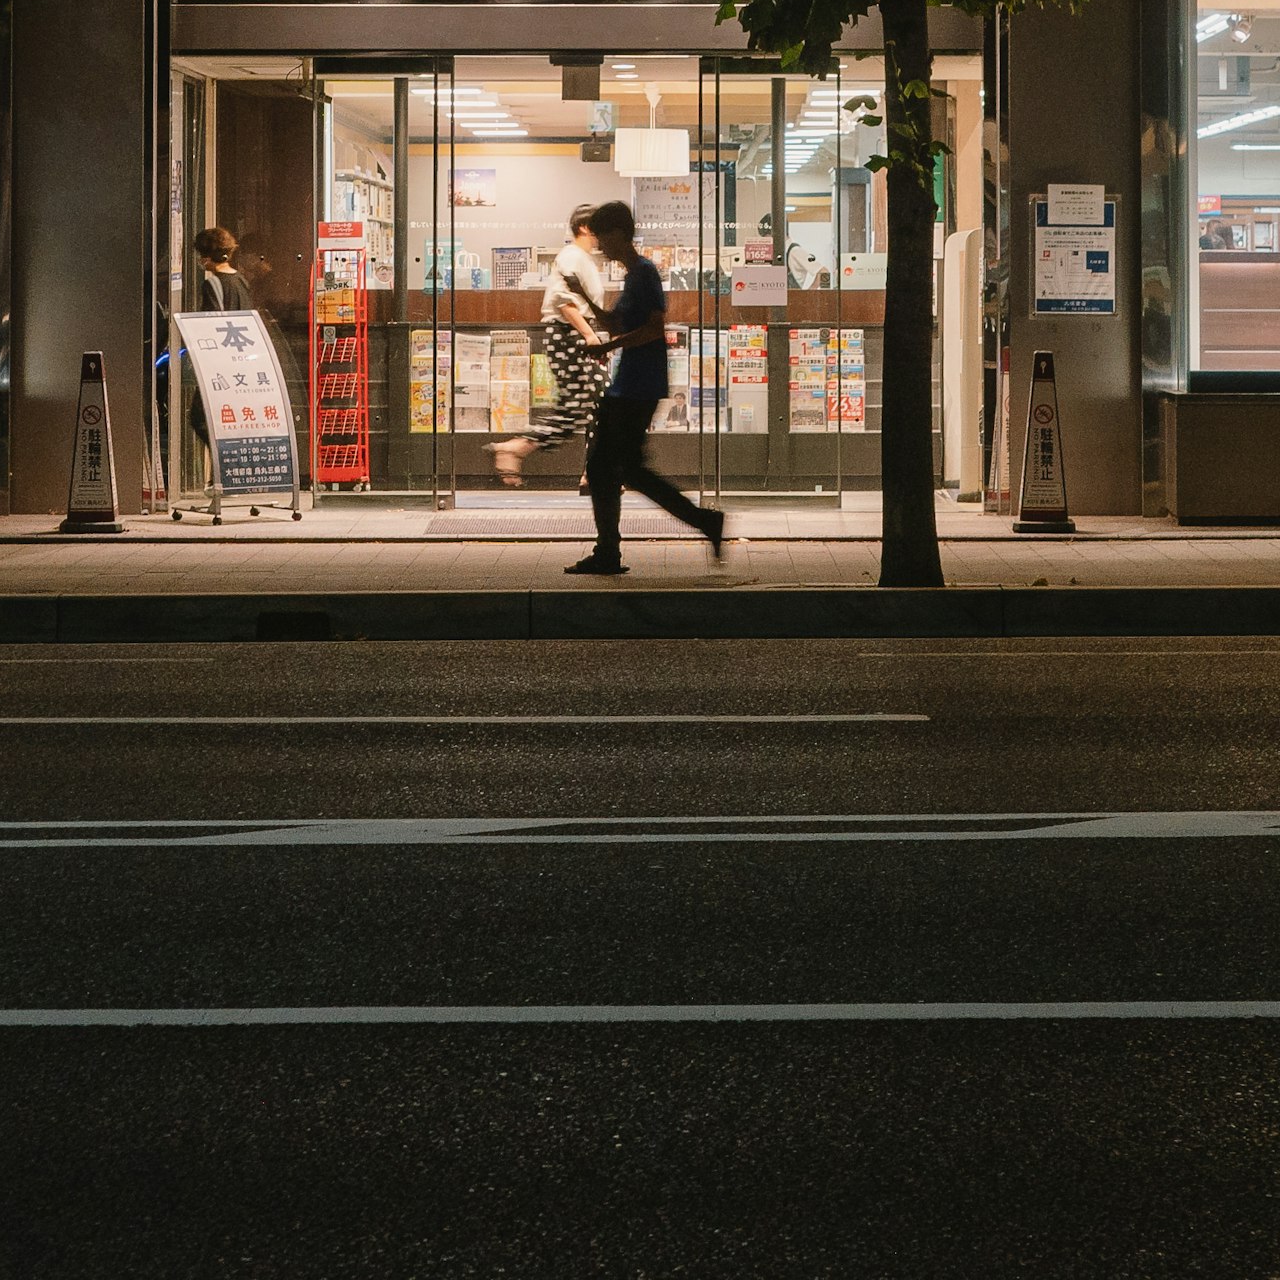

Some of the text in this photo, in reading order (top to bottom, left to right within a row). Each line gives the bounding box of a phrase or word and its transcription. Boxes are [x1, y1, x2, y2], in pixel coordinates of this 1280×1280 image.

[215, 321, 255, 352] 本
[233, 372, 271, 386] 文具
[242, 405, 279, 421] 免税
[1033, 428, 1039, 440] NO
[88, 428, 102, 481] 駐輪禁止
[1040, 427, 1054, 480] 駐輪禁止
[225, 467, 253, 477] 大垣書店
